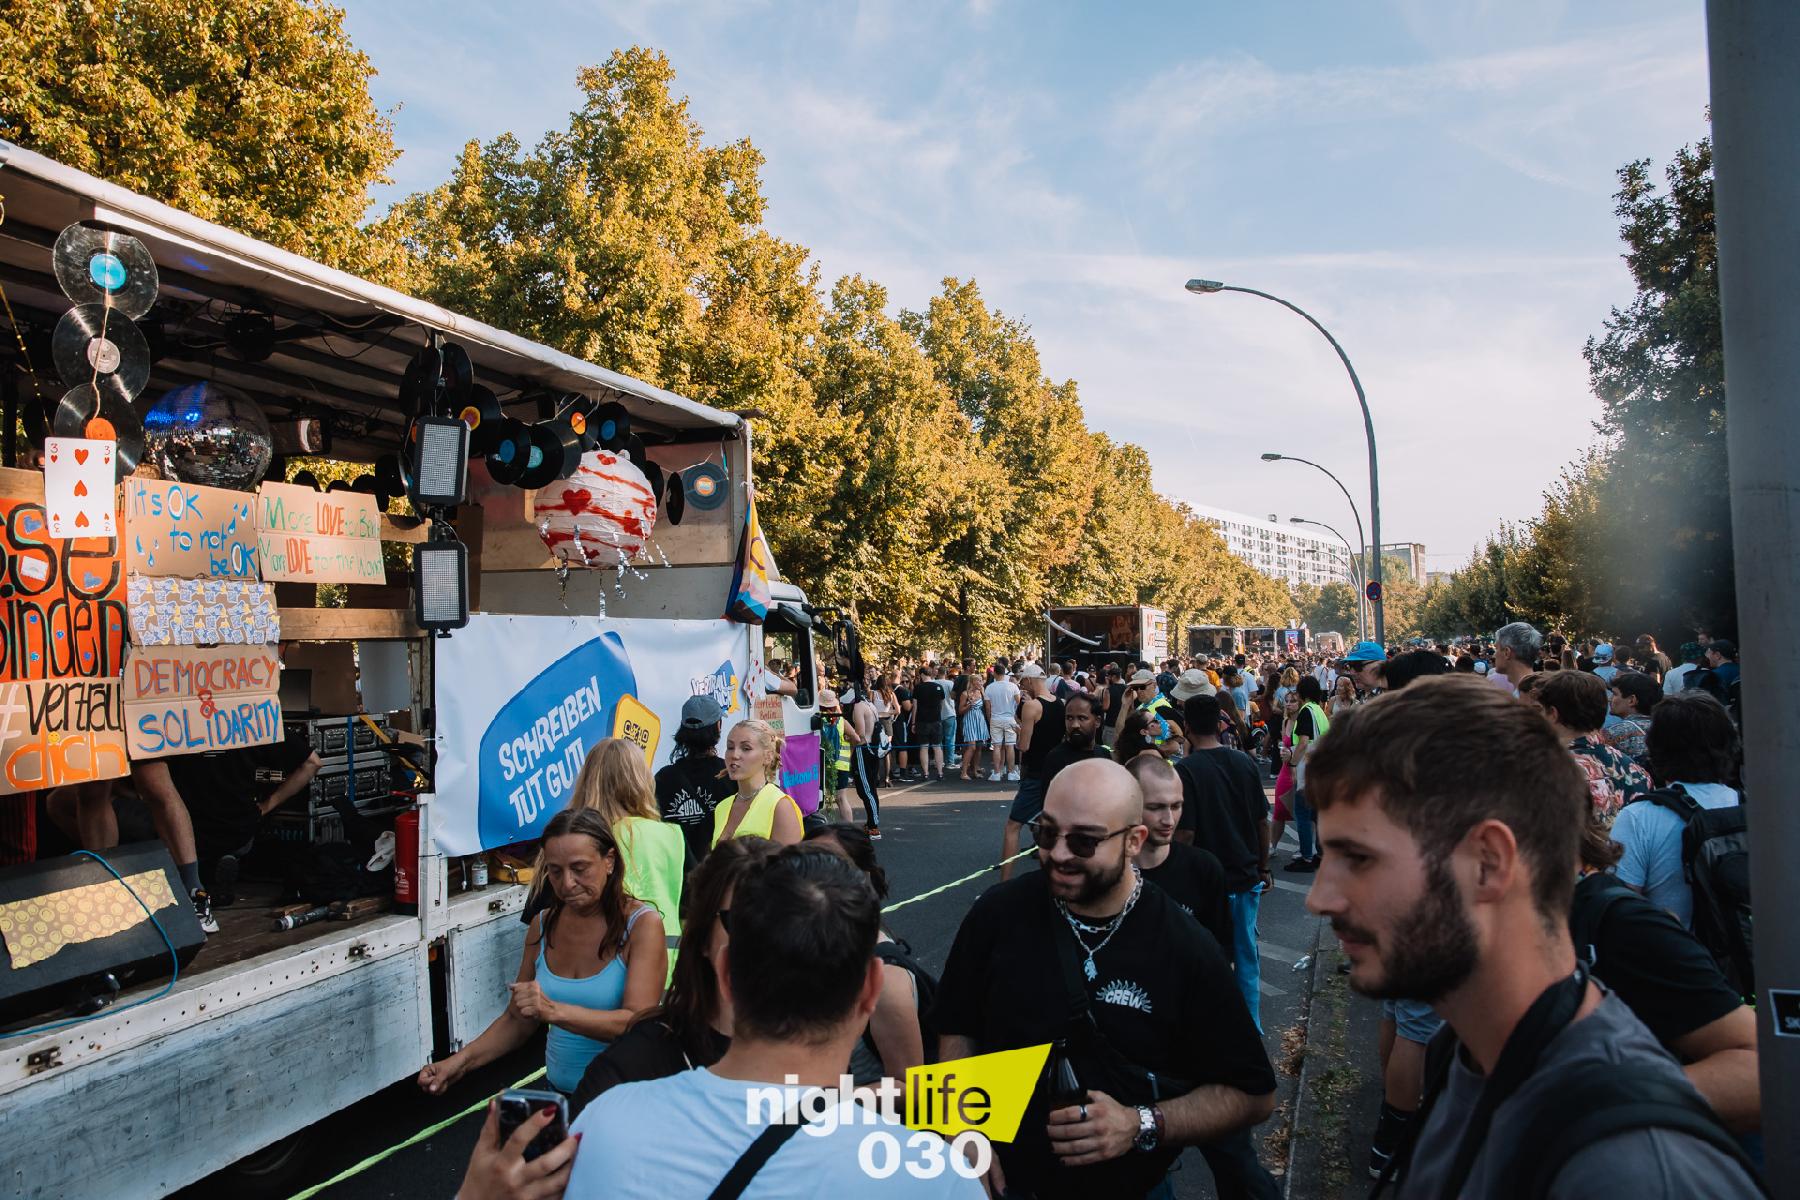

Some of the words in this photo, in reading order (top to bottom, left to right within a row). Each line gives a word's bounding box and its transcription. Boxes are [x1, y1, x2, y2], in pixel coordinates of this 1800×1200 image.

[167, 485, 203, 520] OK
[316, 501, 345, 536] LOVE
[0, 502, 121, 601] se
[169, 523, 193, 552] to
[200, 523, 228, 551] not
[286, 537, 314, 575] LOVE
[210, 552, 231, 576] be
[230, 541, 260, 578] OK
[0, 580, 127, 681] inden
[134, 656, 277, 698] DEMOCRACY
[498, 675, 602, 781] SCHREIBEN
[5, 722, 130, 789] dich
[509, 768, 546, 828] TUT
[1105, 989, 1142, 1010] CREW
